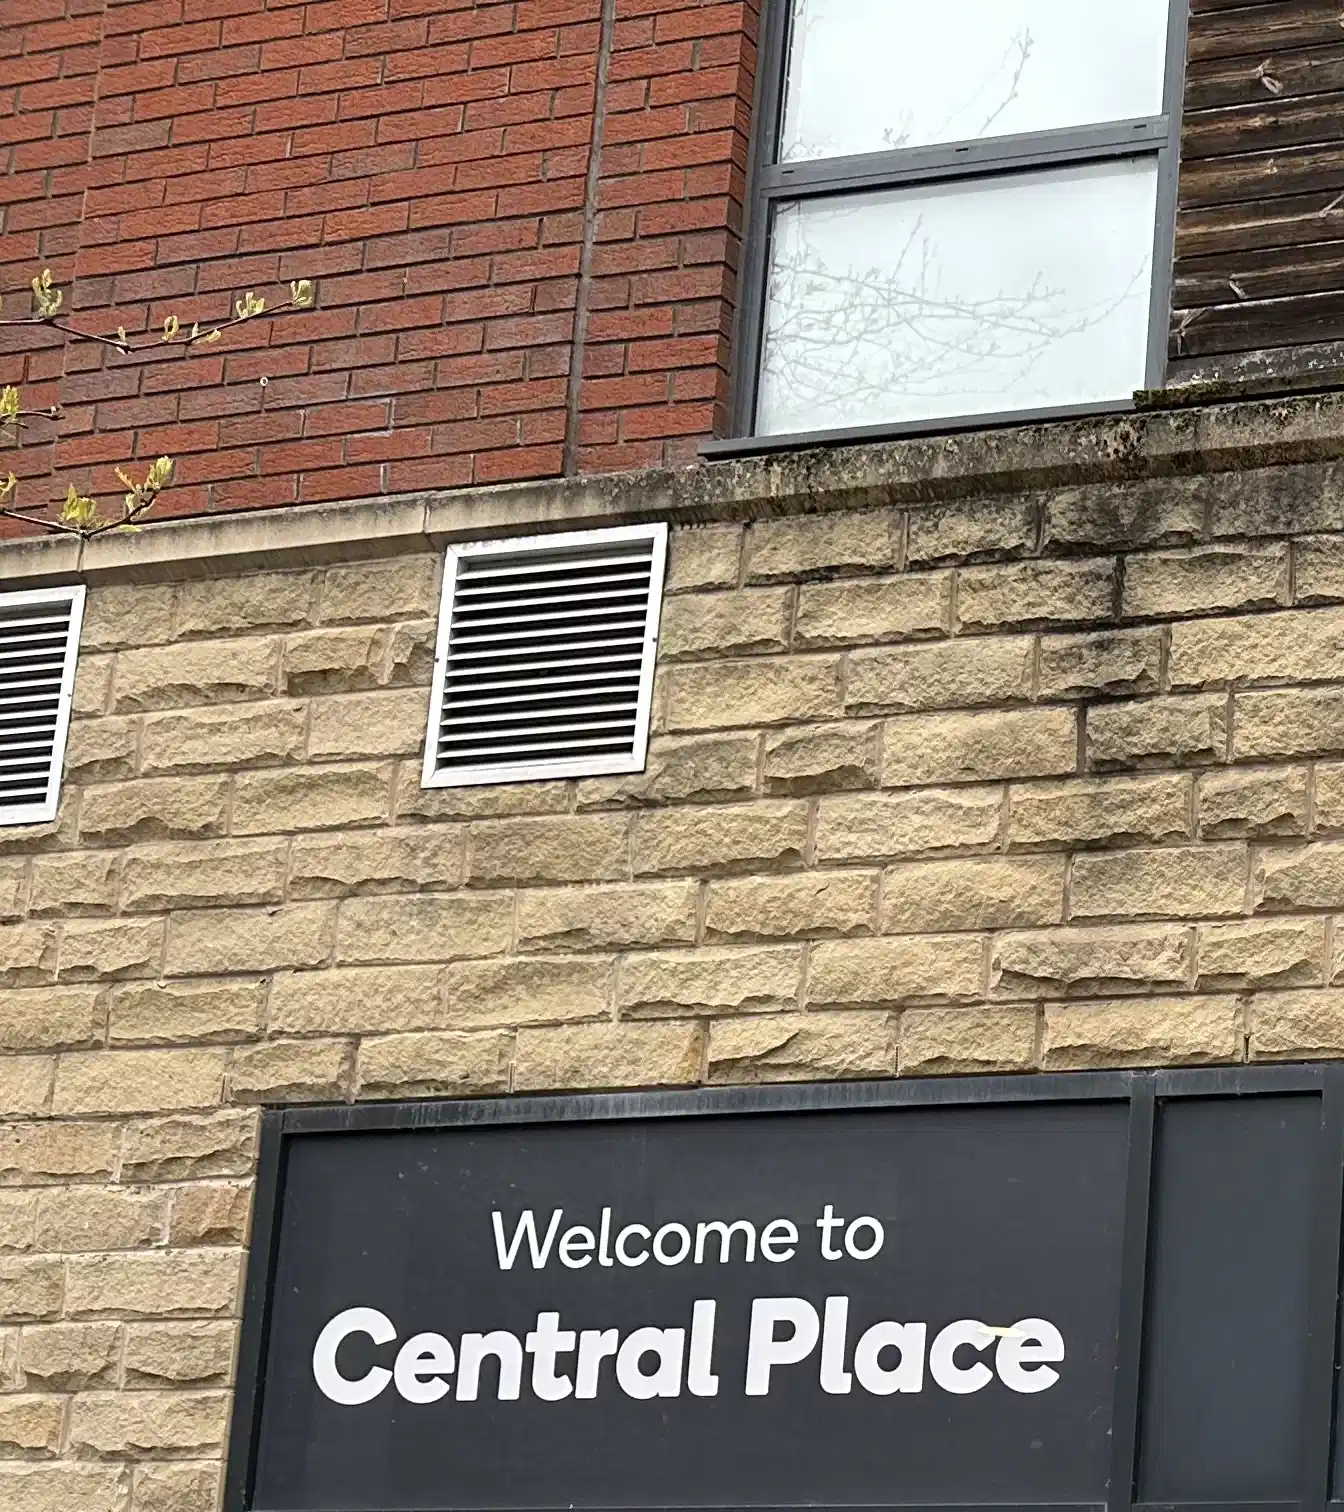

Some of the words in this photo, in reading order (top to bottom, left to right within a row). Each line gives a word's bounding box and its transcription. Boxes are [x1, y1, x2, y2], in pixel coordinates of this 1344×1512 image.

[491, 1206, 797, 1271] Welcome
[816, 1204, 885, 1261] to
[312, 1299, 719, 1406] Central
[745, 1295, 1065, 1396] Place
